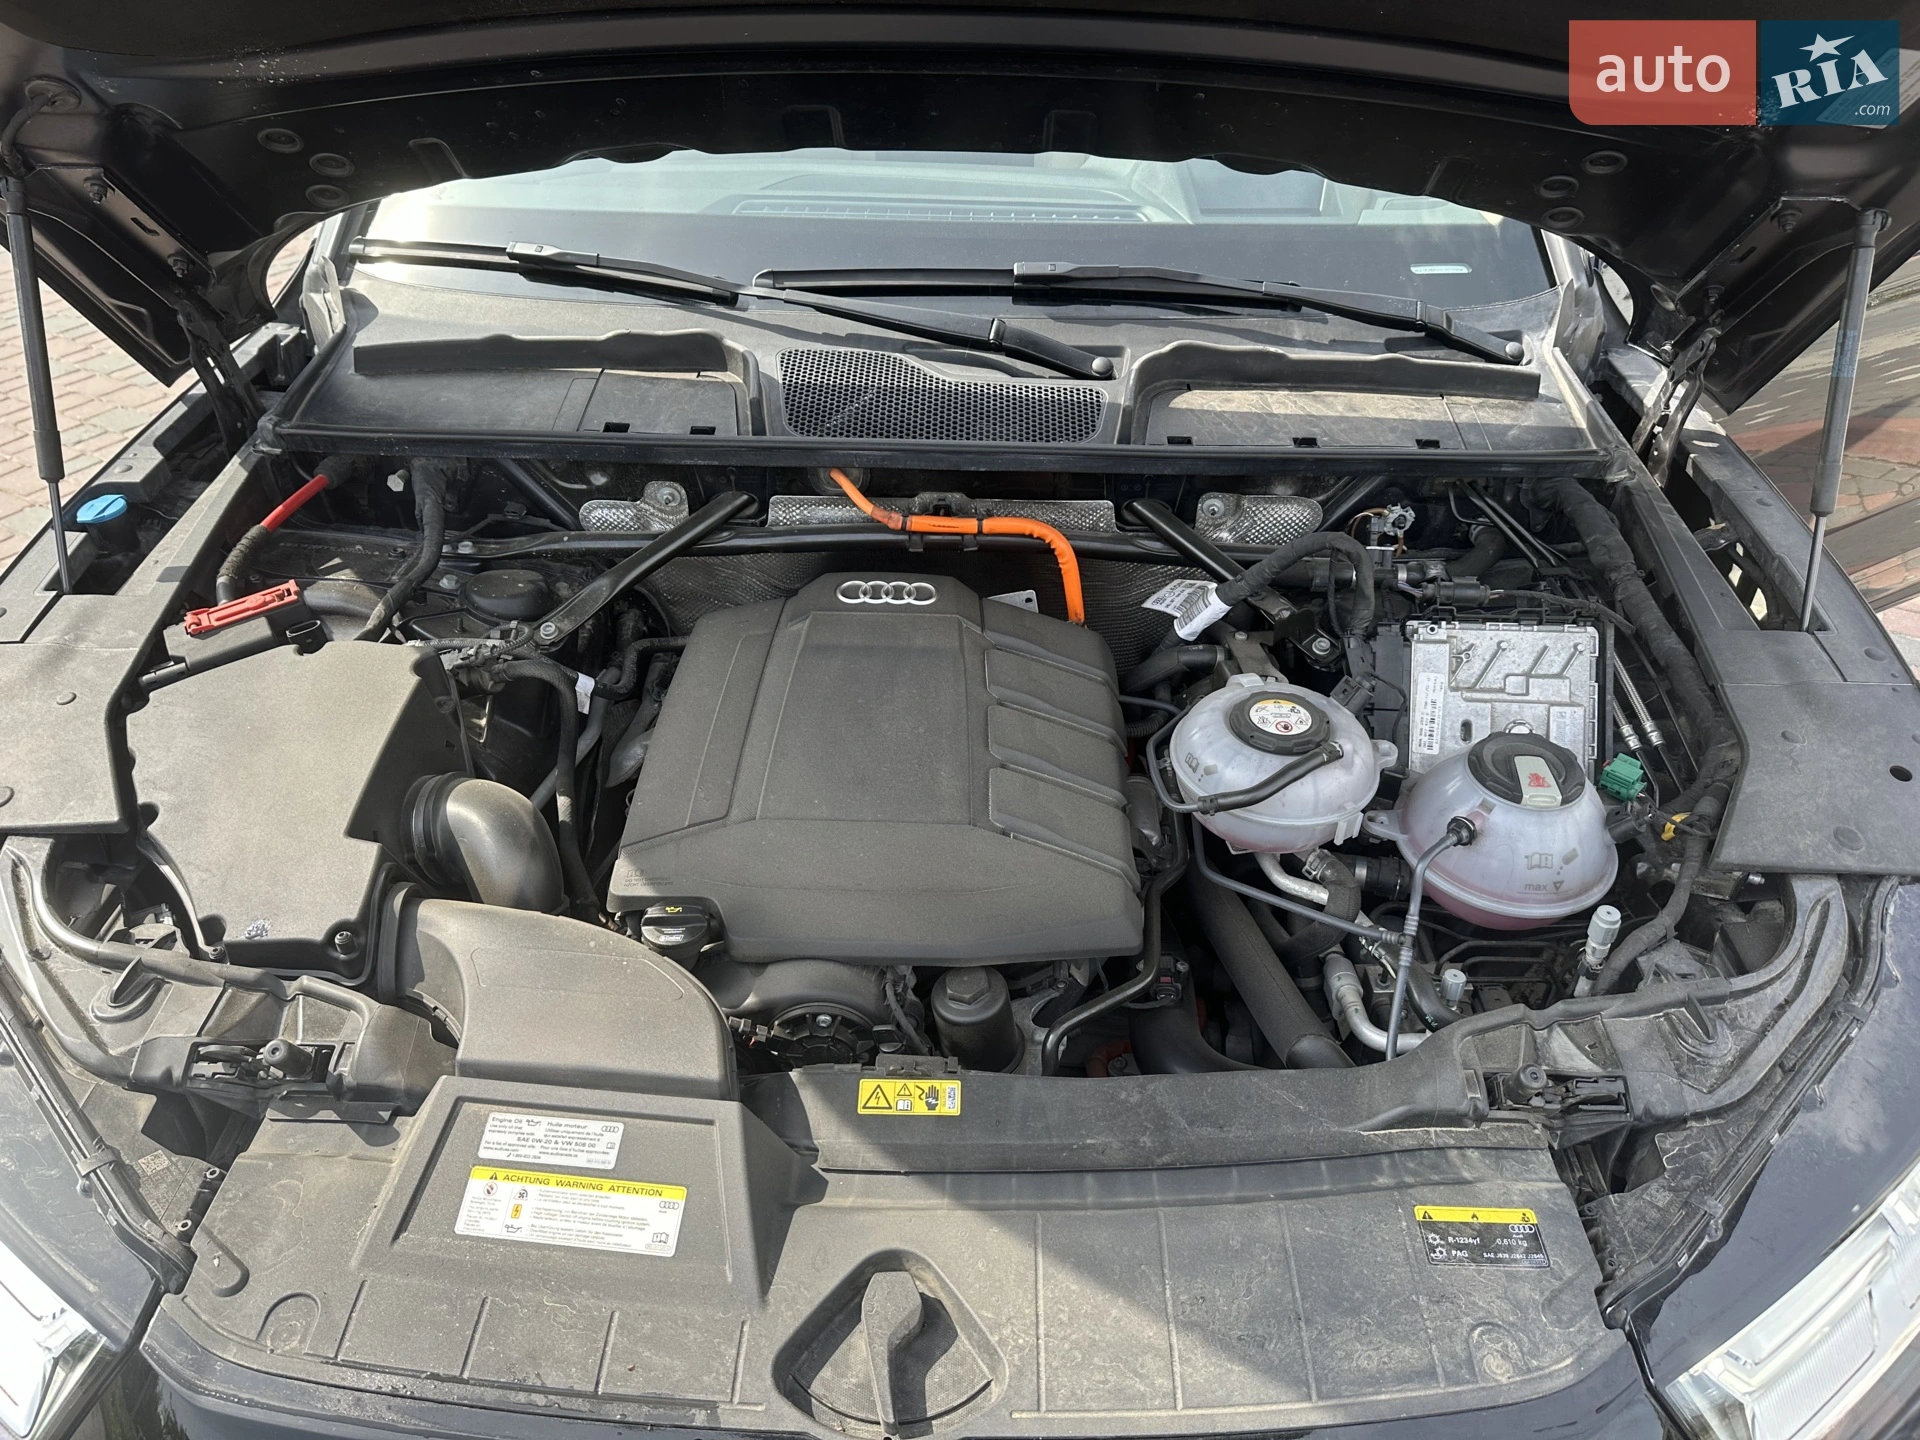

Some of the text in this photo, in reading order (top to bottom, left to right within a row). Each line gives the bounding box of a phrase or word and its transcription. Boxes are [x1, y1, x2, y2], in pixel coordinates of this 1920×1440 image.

[1524, 883, 1548, 891] max
[502, 1174, 550, 1186] ACHTUNG
[555, 1179, 604, 1192] WARNING
[608, 1184, 663, 1198] ATTENTION
[1447, 1236, 1481, 1245] R-1234yf
[1518, 1239, 1528, 1247] kg
[1451, 1249, 1469, 1258] PAG
